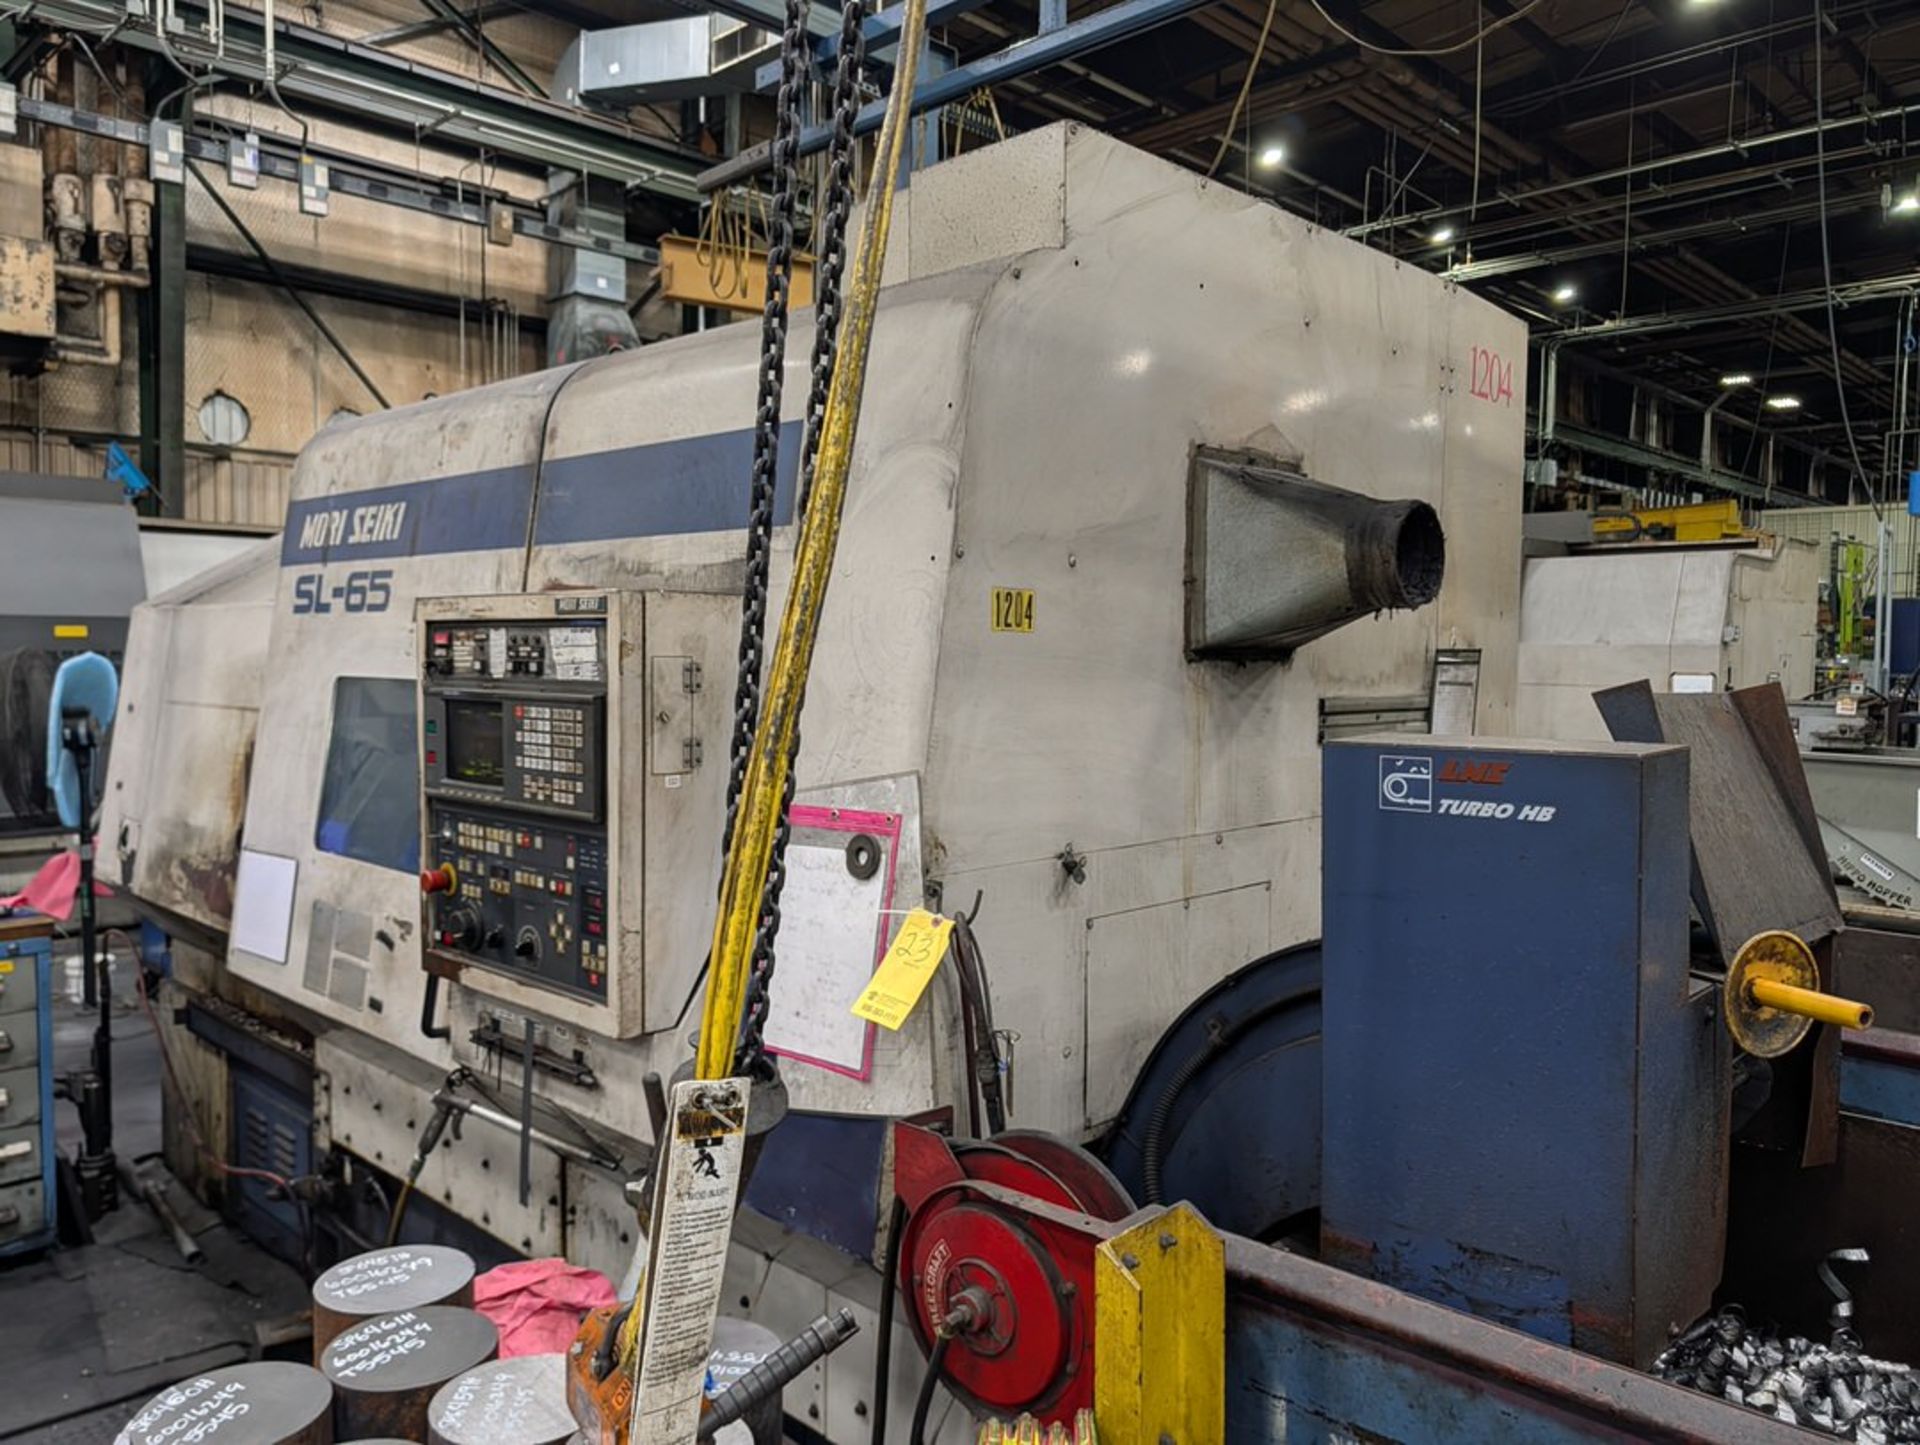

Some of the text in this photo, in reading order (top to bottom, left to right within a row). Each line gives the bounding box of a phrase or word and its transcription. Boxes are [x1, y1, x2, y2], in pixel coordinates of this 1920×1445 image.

[1469, 346, 1513, 408] 1204
[299, 501, 407, 550] MORI SEIKI
[292, 569, 394, 614] SL-65
[996, 591, 1033, 630] 1204
[1438, 798, 1557, 823] TURBO HB
[1836, 854, 1867, 883] HIPPO
[1866, 879, 1913, 907] HOPPER
[895, 932, 934, 963] 23
